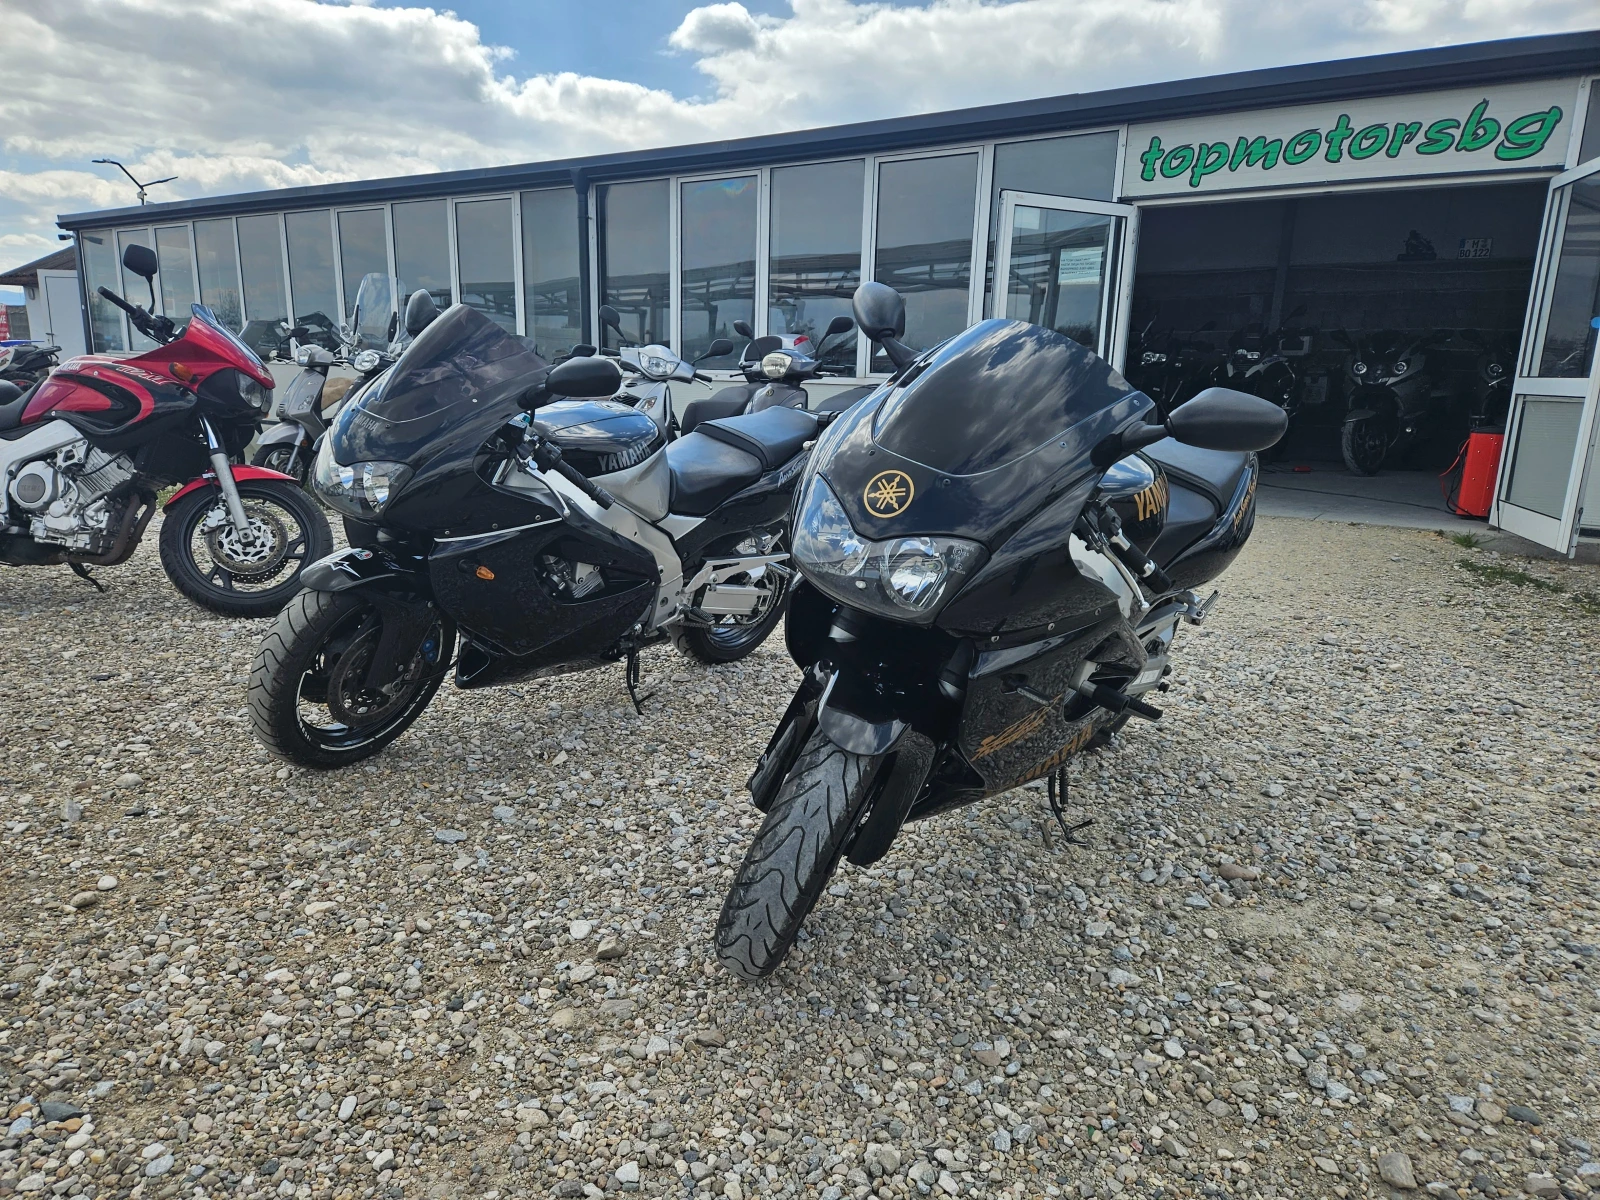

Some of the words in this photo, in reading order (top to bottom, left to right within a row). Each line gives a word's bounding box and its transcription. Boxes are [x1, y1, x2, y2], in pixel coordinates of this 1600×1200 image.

[1140, 98, 1563, 188] topmotorsbg
[597, 440, 652, 472] YAMAHA
[1133, 474, 1168, 521] YAM
